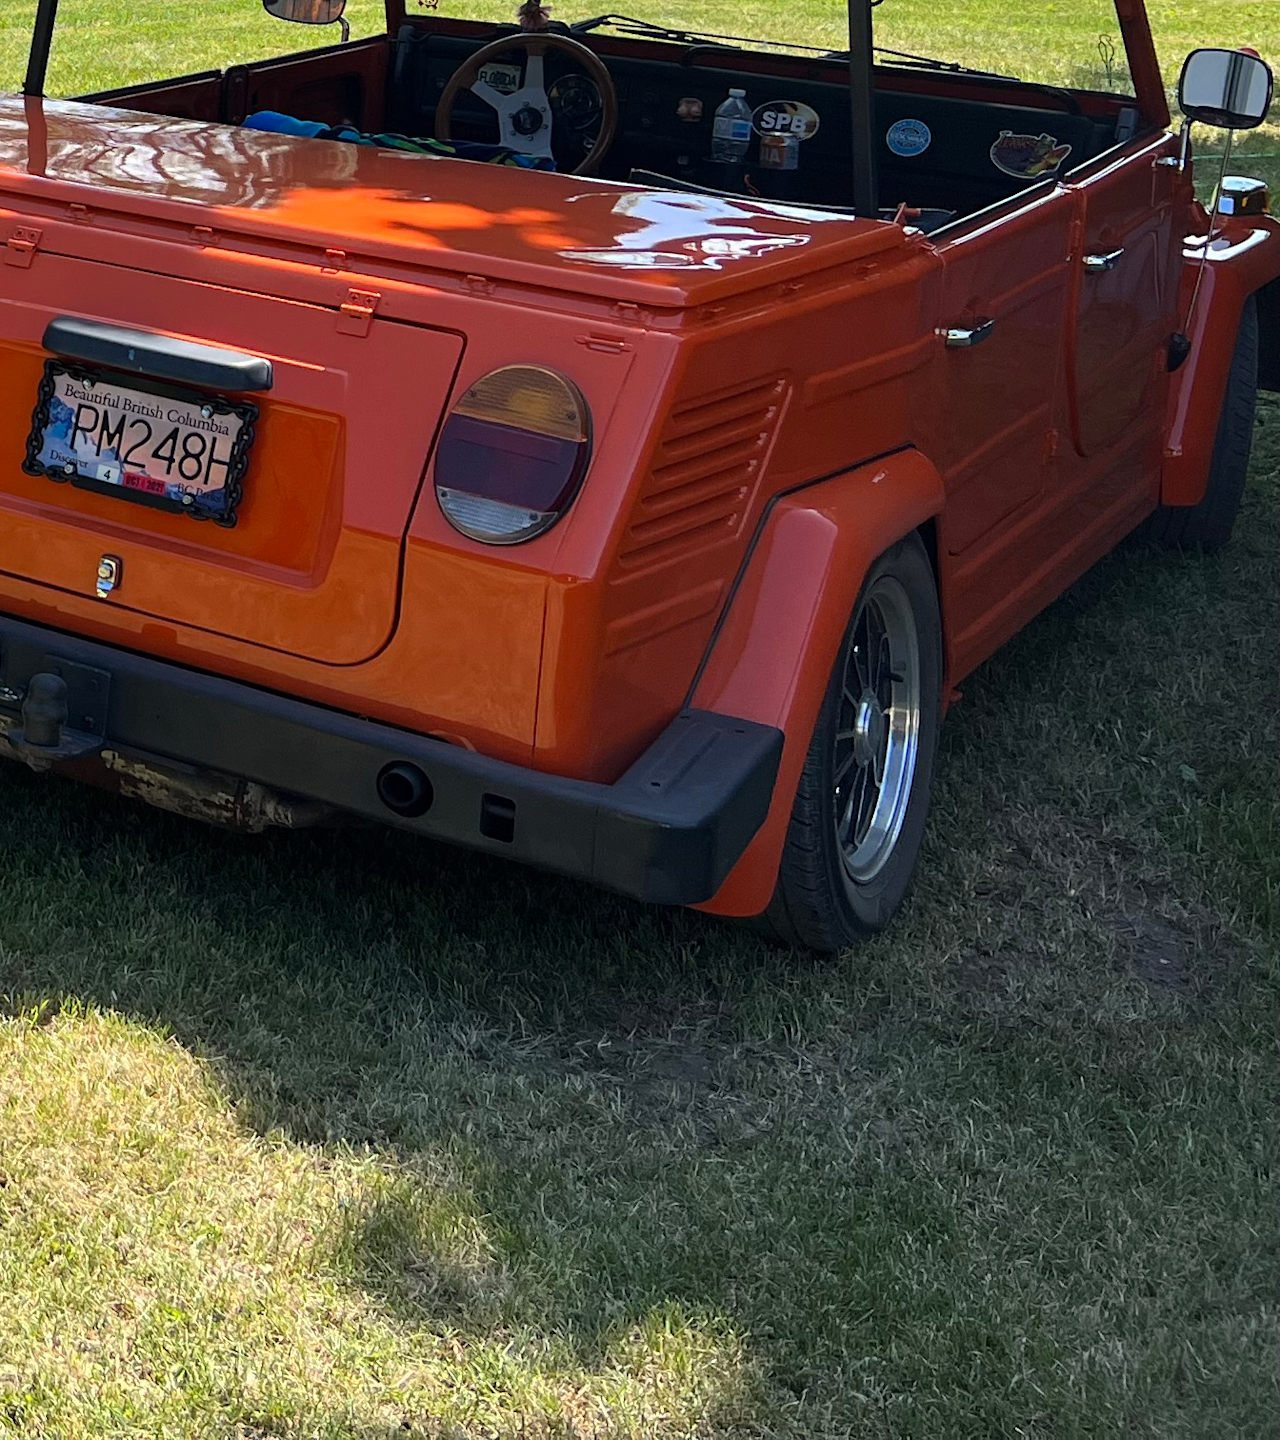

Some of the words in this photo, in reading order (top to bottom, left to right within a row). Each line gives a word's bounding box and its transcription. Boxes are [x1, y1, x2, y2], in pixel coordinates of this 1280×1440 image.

[760, 110, 808, 134] SPB
[65, 384, 120, 409] Beautiful
[122, 398, 163, 420] British
[167, 409, 229, 436] Columbia
[70, 403, 235, 485] PM248H
[103, 470, 111, 481] 4
